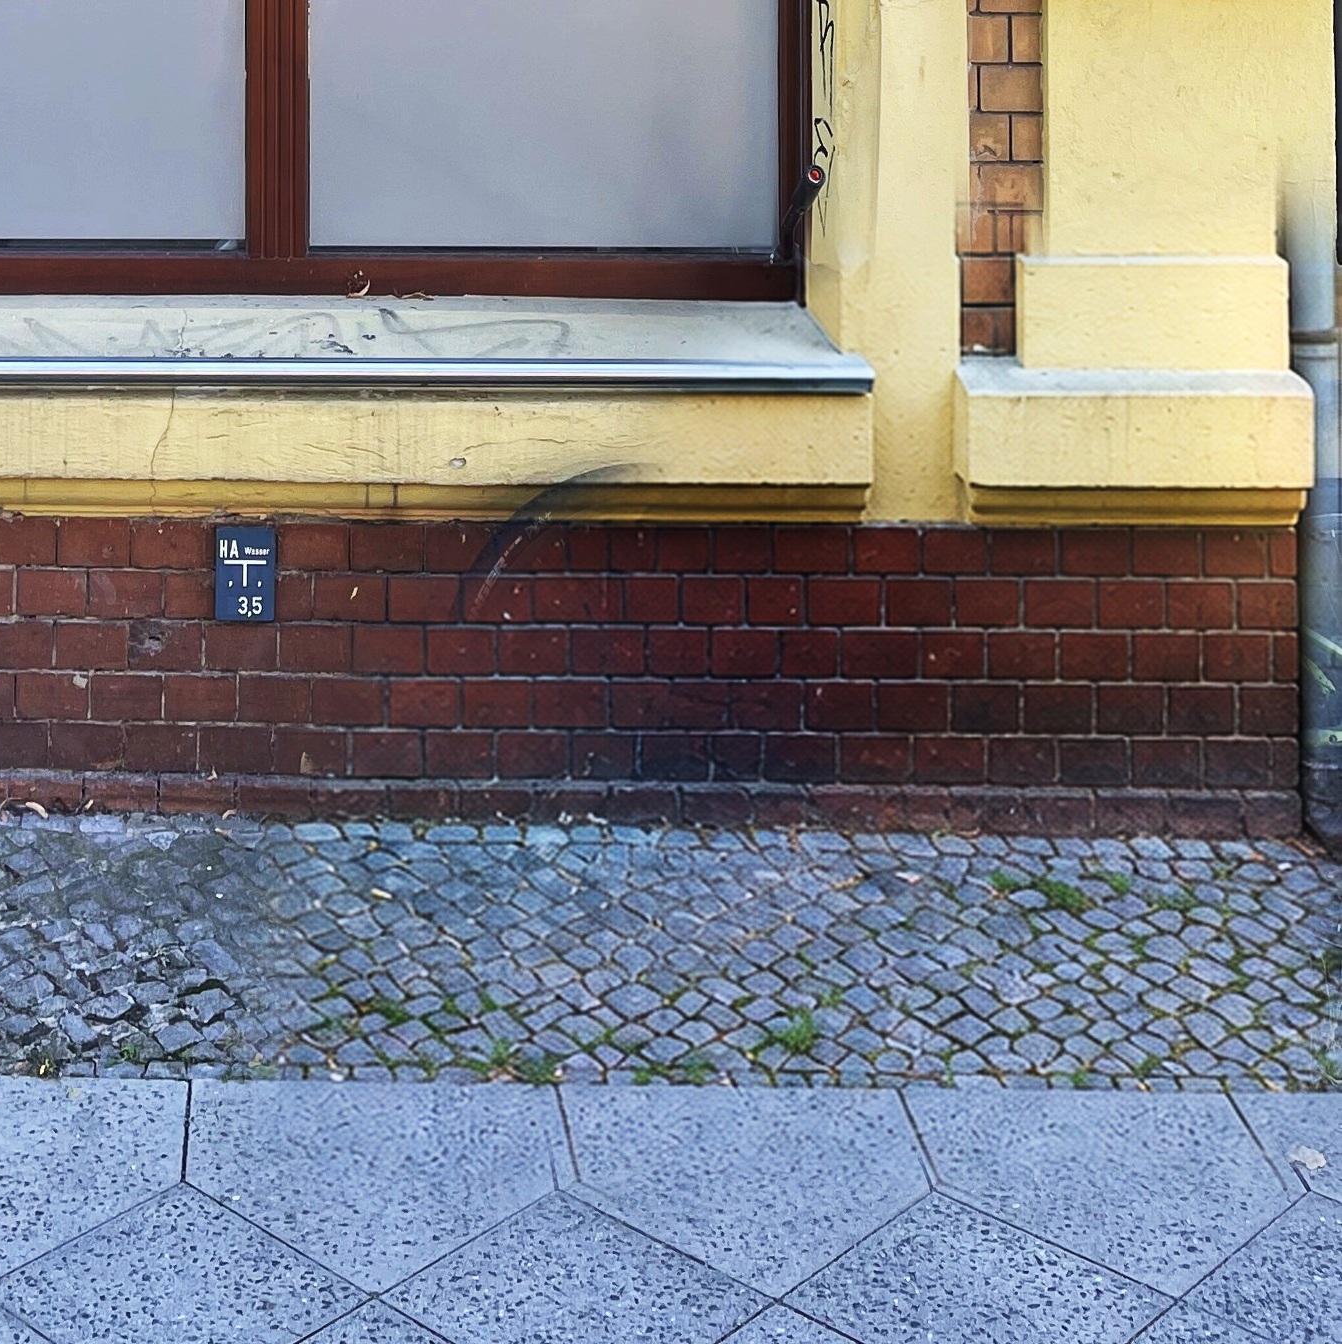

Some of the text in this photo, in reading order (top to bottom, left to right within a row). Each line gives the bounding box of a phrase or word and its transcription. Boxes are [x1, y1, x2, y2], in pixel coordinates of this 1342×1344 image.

[219, 539, 270, 559] HA Wasser
[237, 596, 263, 618] 3,5
